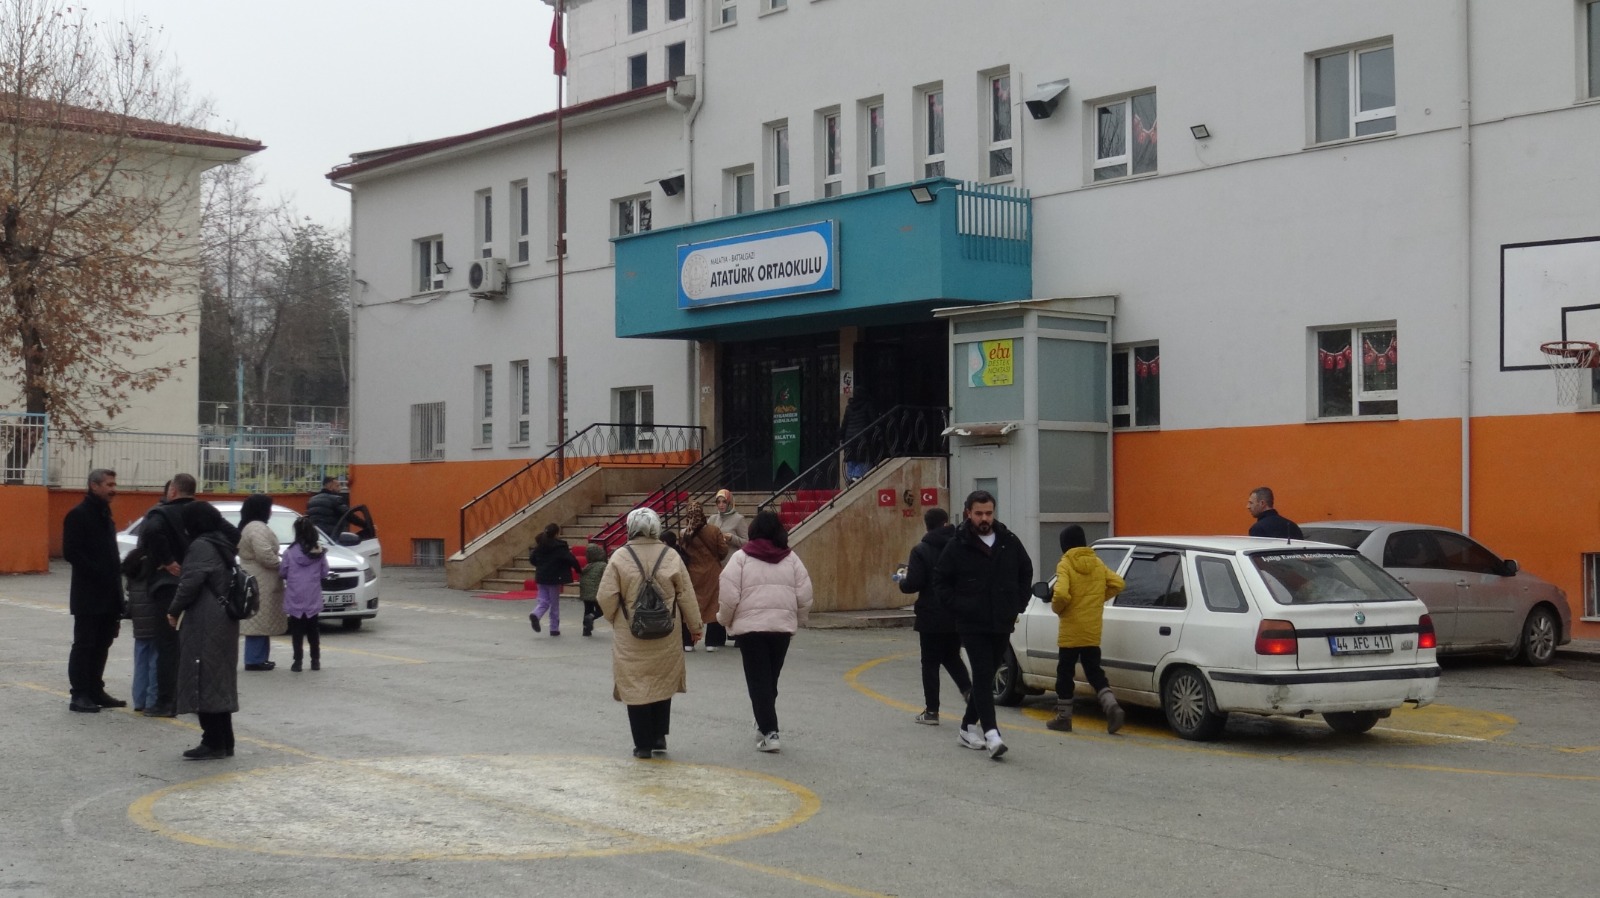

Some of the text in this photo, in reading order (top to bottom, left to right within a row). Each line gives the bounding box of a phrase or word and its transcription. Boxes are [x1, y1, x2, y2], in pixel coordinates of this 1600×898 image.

[710, 256, 728, 264] MALATYA
[710, 256, 822, 288] ATATÜRK ORTAOKULU
[988, 359, 1010, 367] DESTEK
[1336, 637, 1348, 650] 44
[1353, 636, 1370, 650] AFC
[1374, 635, 1390, 649] 411
